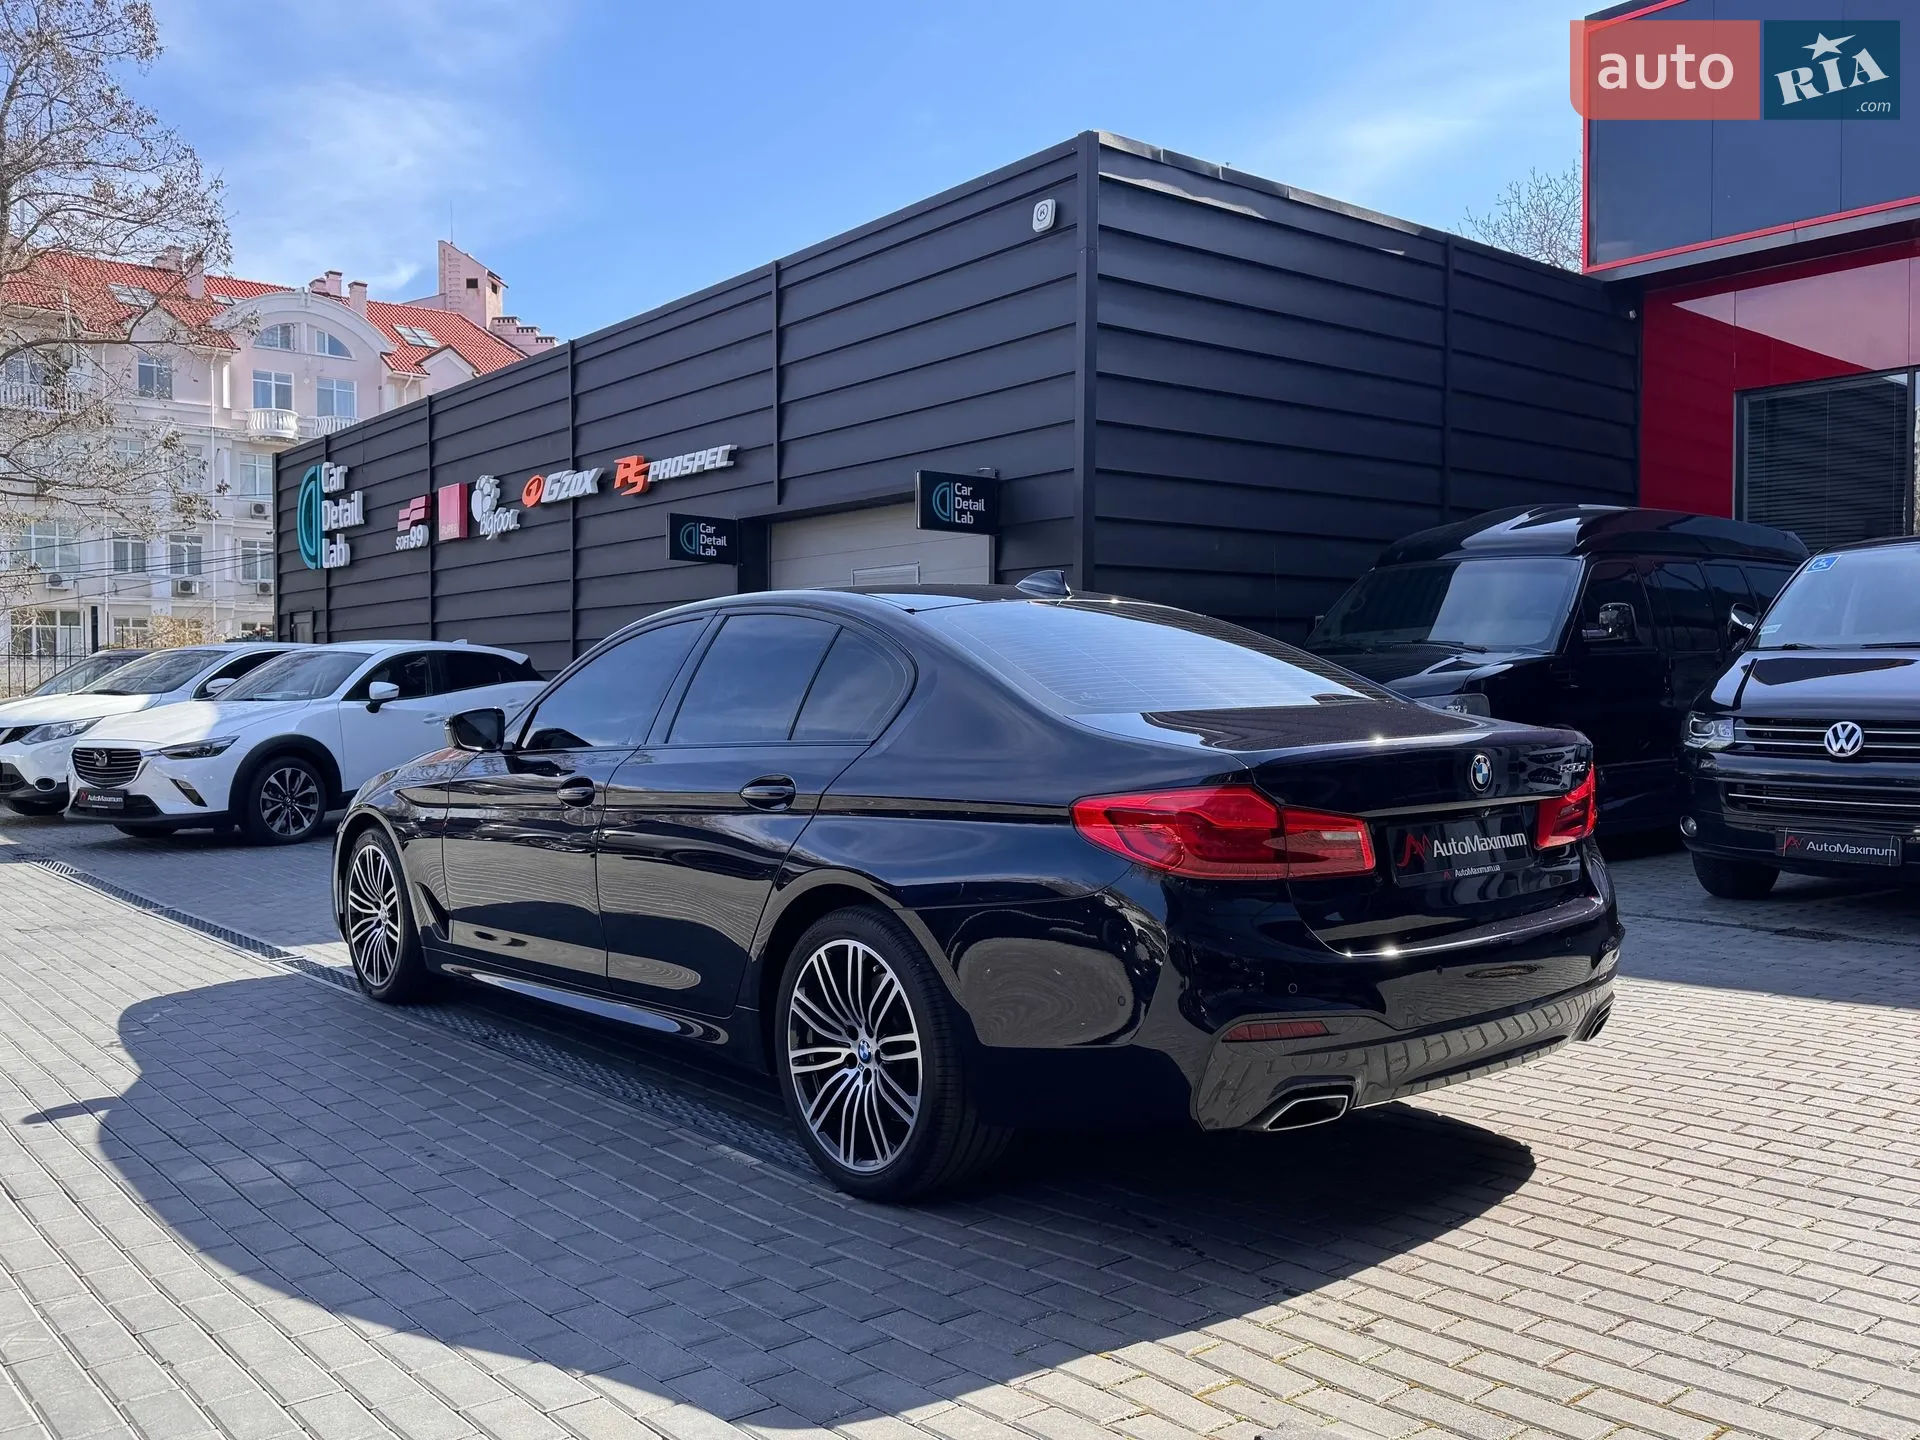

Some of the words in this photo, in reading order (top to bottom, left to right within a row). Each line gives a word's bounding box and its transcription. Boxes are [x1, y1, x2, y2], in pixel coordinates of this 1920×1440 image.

[648, 444, 737, 481] PROSPEC
[322, 462, 347, 493] Car
[955, 483, 973, 496] Car
[322, 491, 364, 531] Detail
[955, 497, 985, 511] Detail
[955, 511, 974, 524] Lab
[700, 523, 716, 533] Car
[700, 534, 727, 546] Detail
[322, 533, 350, 568] Lab
[700, 545, 717, 556] Lab
[1433, 833, 1527, 858] AutoMaximum
[1806, 841, 1897, 857] AutoMaximum
